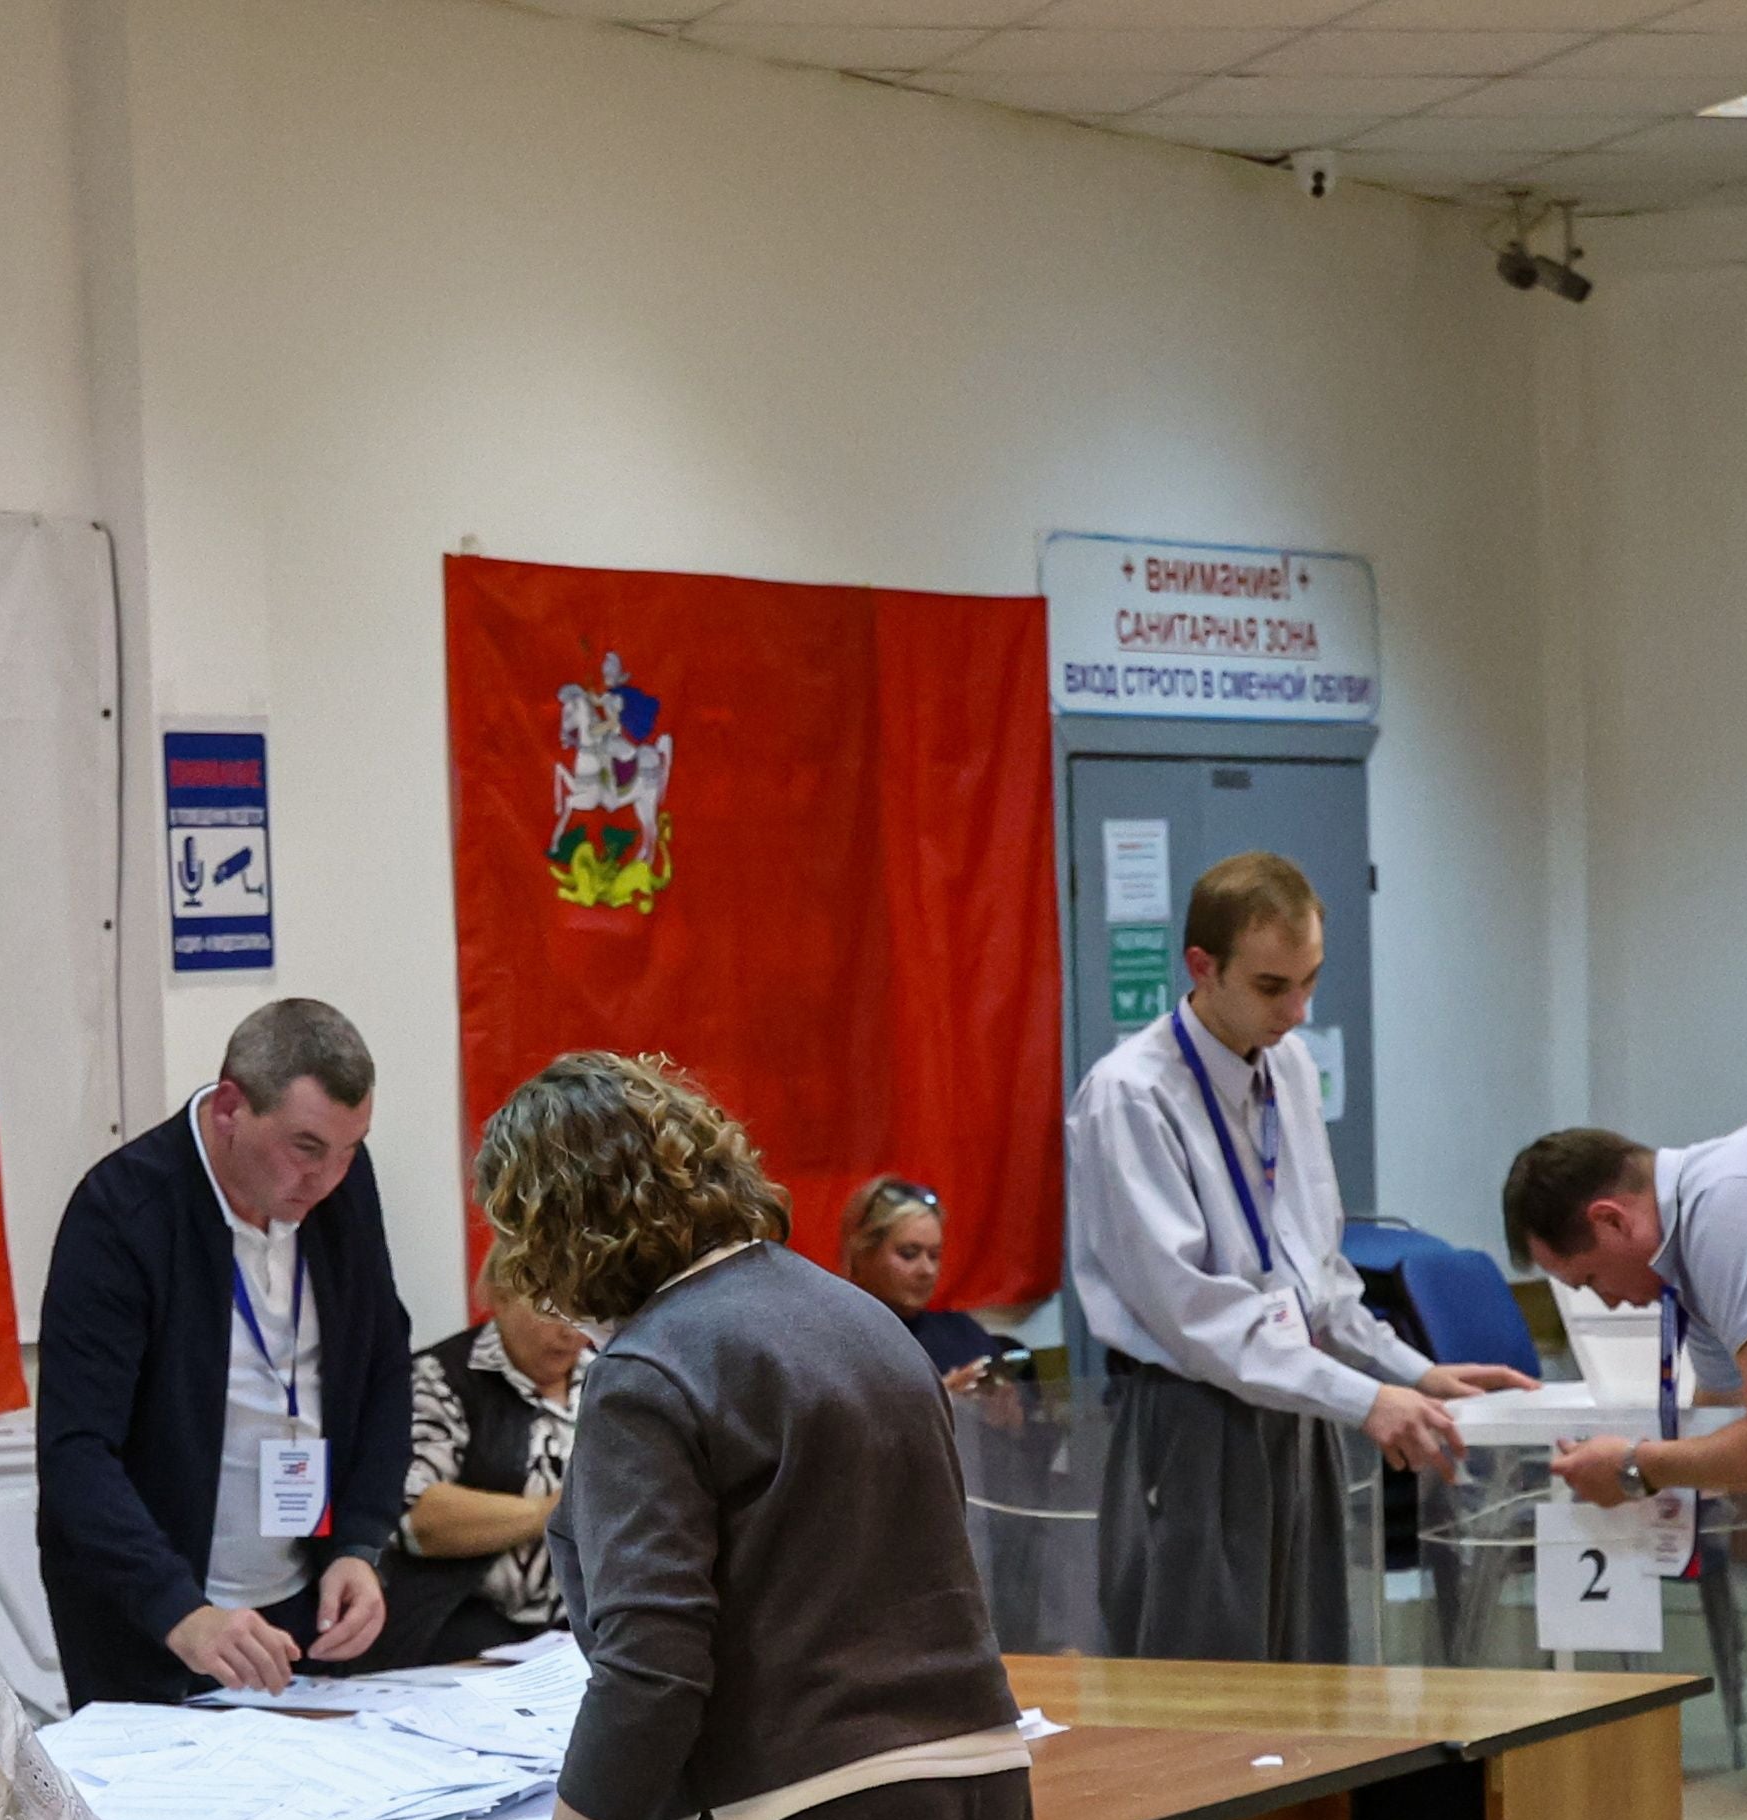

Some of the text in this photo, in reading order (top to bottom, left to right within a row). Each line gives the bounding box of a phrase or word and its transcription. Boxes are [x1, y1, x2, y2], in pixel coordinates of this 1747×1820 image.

[1115, 608, 1319, 653] САНИТАРНАЯ ЗОНА
[1064, 662, 1118, 698] ВХОД
[1123, 664, 1198, 698] СТРОГО
[1201, 668, 1214, 699] В
[1578, 1549, 1610, 1602] 2
